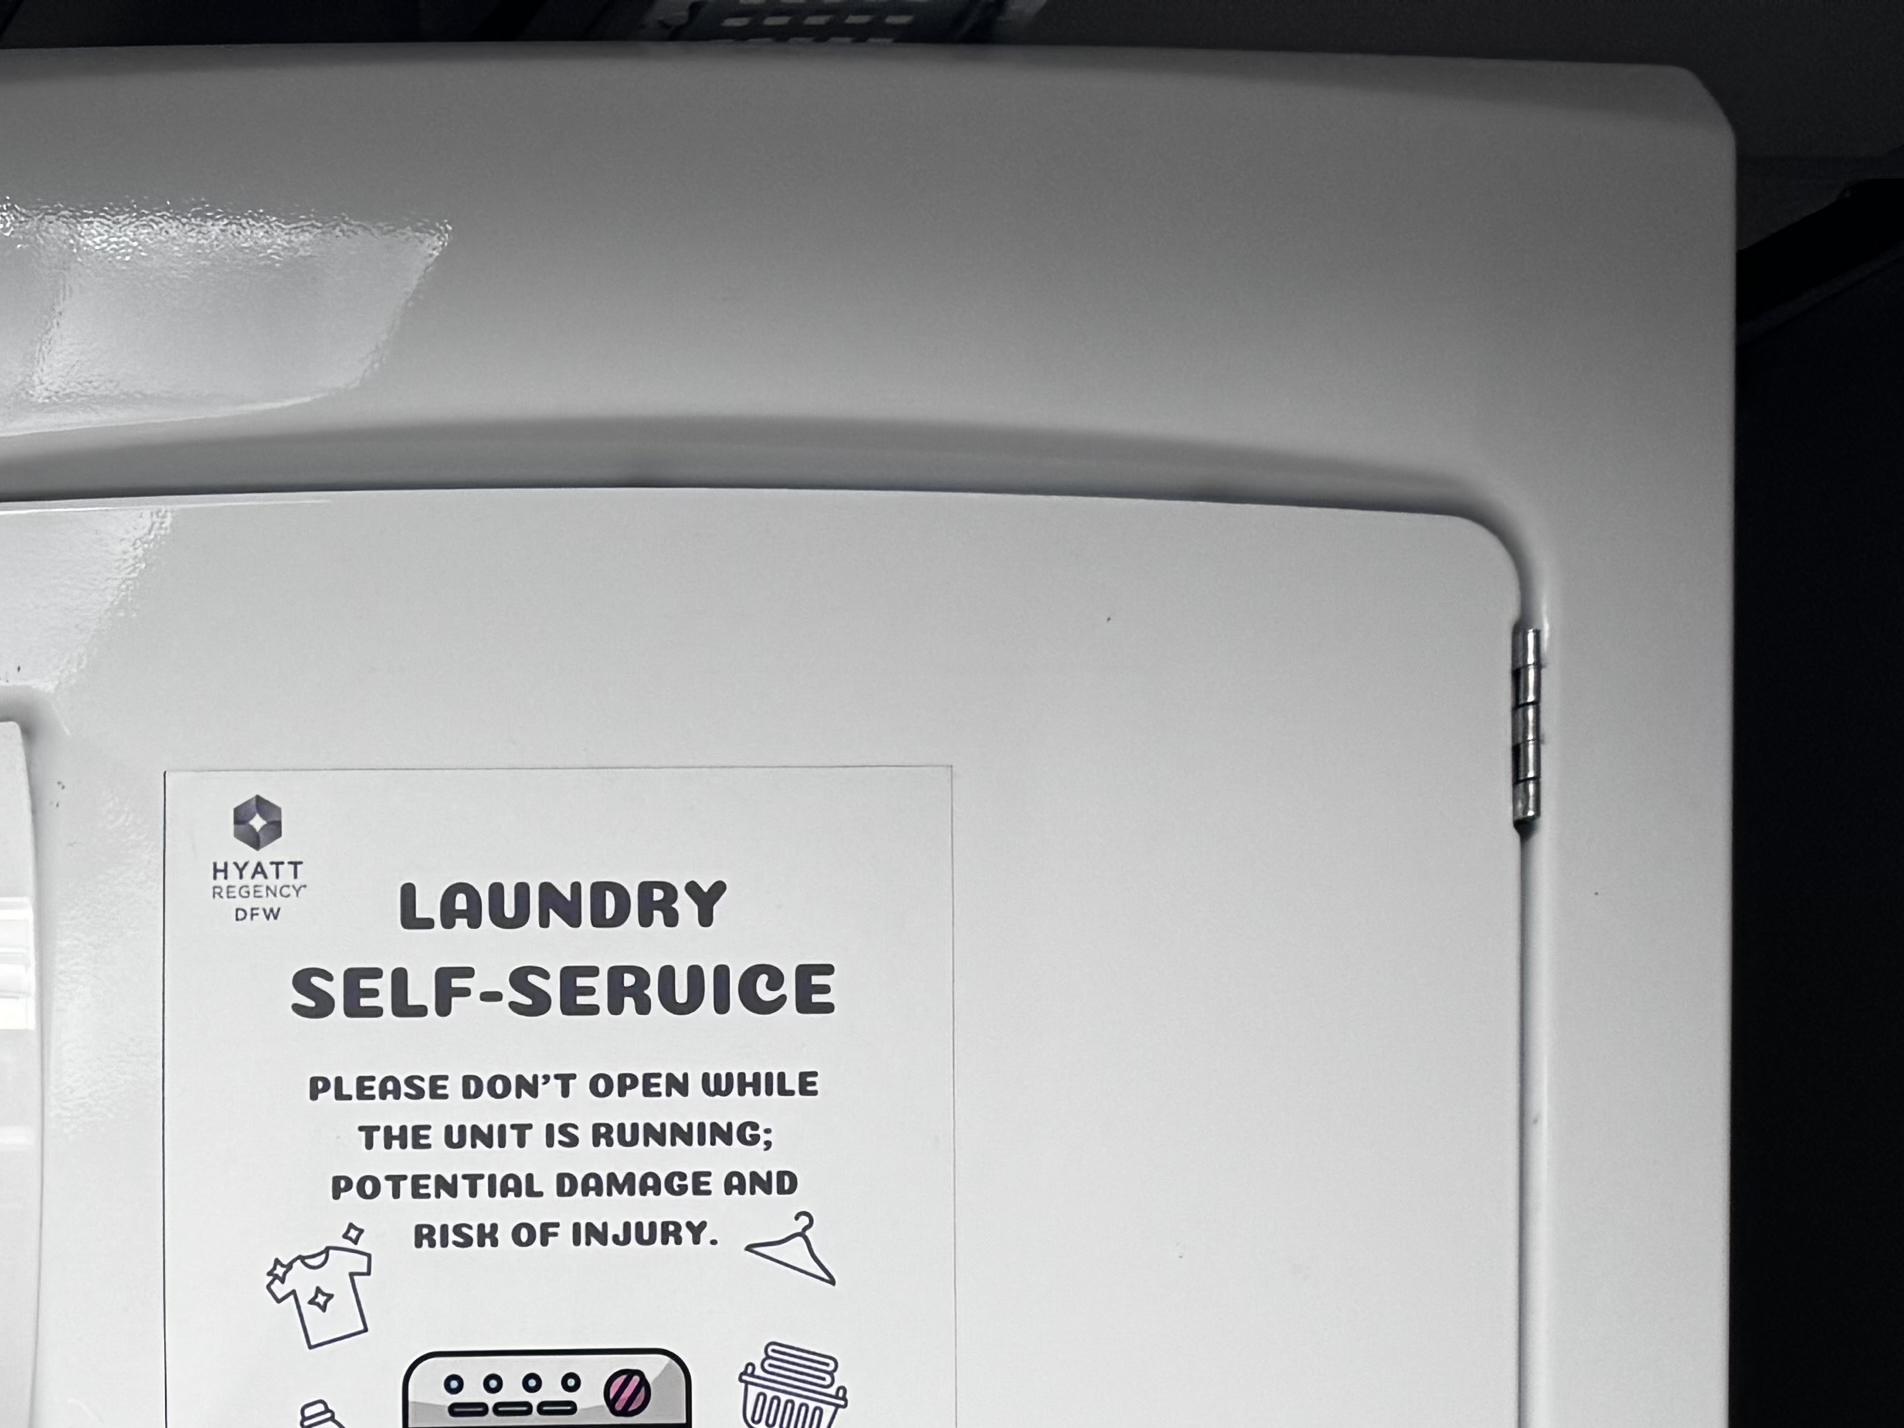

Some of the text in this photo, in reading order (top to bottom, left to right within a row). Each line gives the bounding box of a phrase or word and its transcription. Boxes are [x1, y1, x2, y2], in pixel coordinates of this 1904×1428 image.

[213, 861, 303, 880] HYATT
[213, 884, 307, 899] REGENCY
[400, 880, 727, 930] LAUNDRY
[235, 907, 281, 921] DFW
[291, 964, 835, 1019] SELF-SERVICE
[310, 1071, 818, 1101] PLEASE DON'T OPEN WHILE
[358, 1121, 772, 1151] THE UNIT IS RUNNING;
[332, 1170, 798, 1200] POTENTIAL DAMAGE AND
[414, 1221, 718, 1248] RISK OF INJURY.
